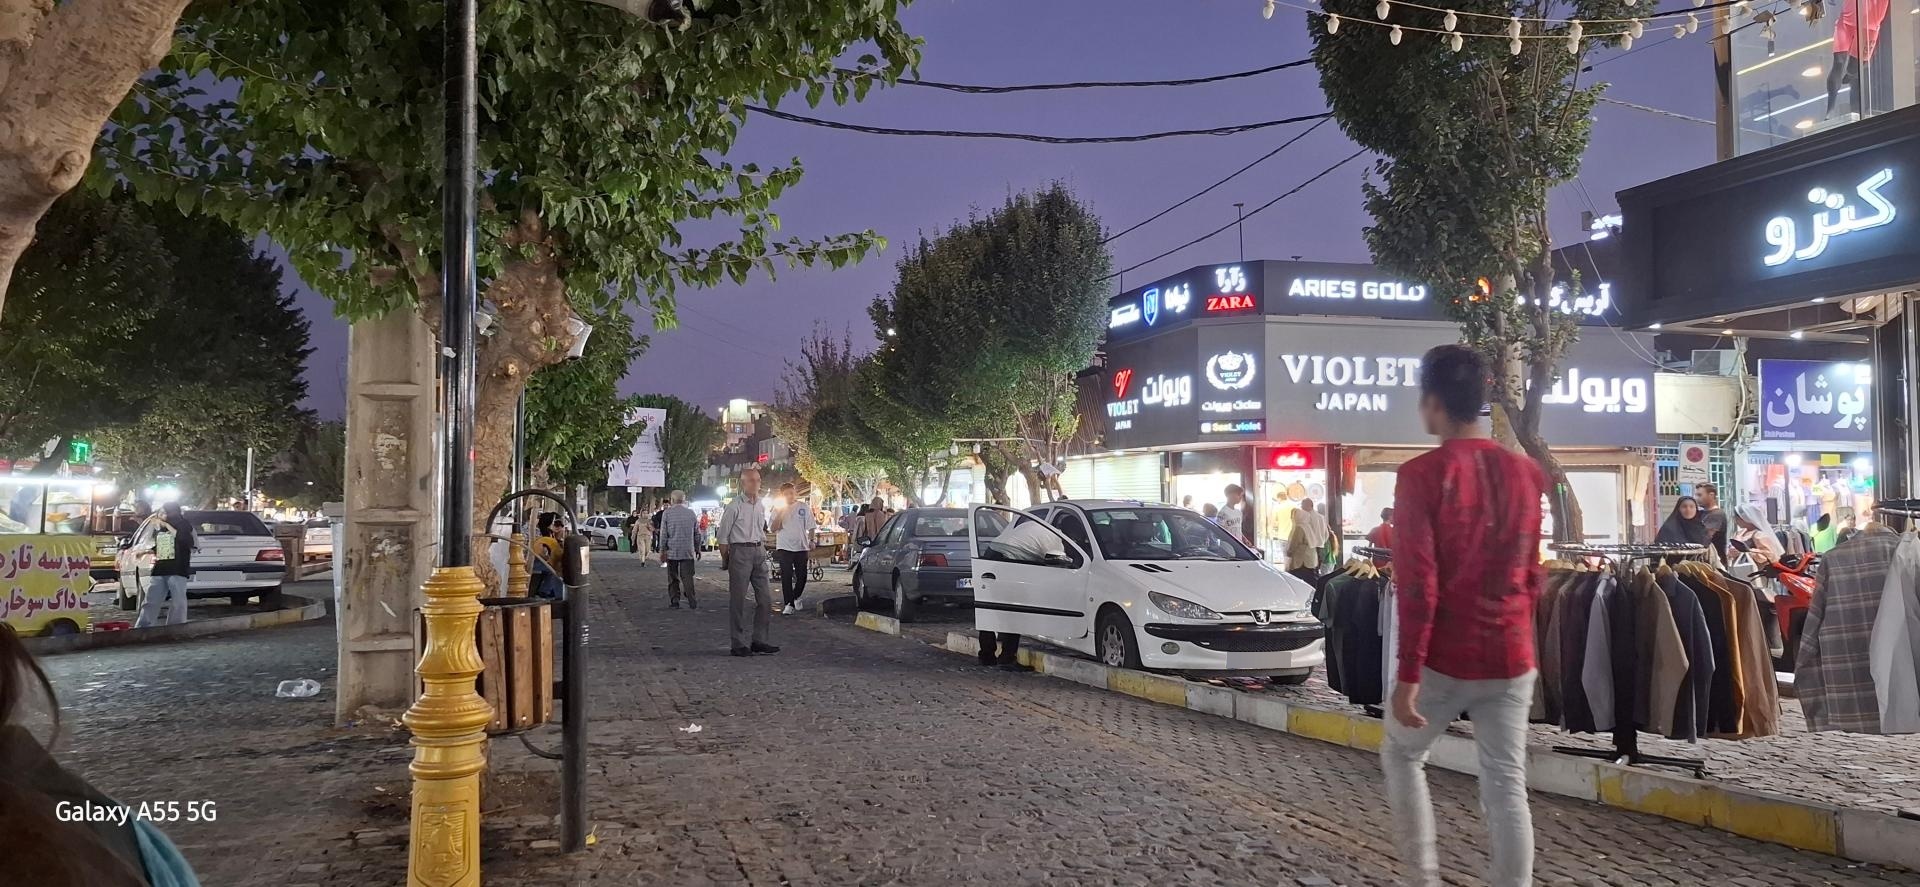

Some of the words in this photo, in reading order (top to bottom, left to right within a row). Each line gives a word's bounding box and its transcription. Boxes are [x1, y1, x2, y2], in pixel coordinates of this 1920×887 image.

[1289, 278, 1356, 299] ARIES
[1362, 281, 1426, 301] GOLD
[1207, 295, 1254, 311] ZARA
[1280, 354, 1421, 387] VIOLET
[1142, 374, 1191, 407] ویولت
[1766, 371, 1867, 431] پوشان
[1106, 399, 1140, 417] VIOLET
[1315, 392, 1388, 412] JAPAN
[1114, 419, 1132, 431] JAPAN
[0, 588, 44, 618] سوخار
[48, 588, 76, 610] داگ
